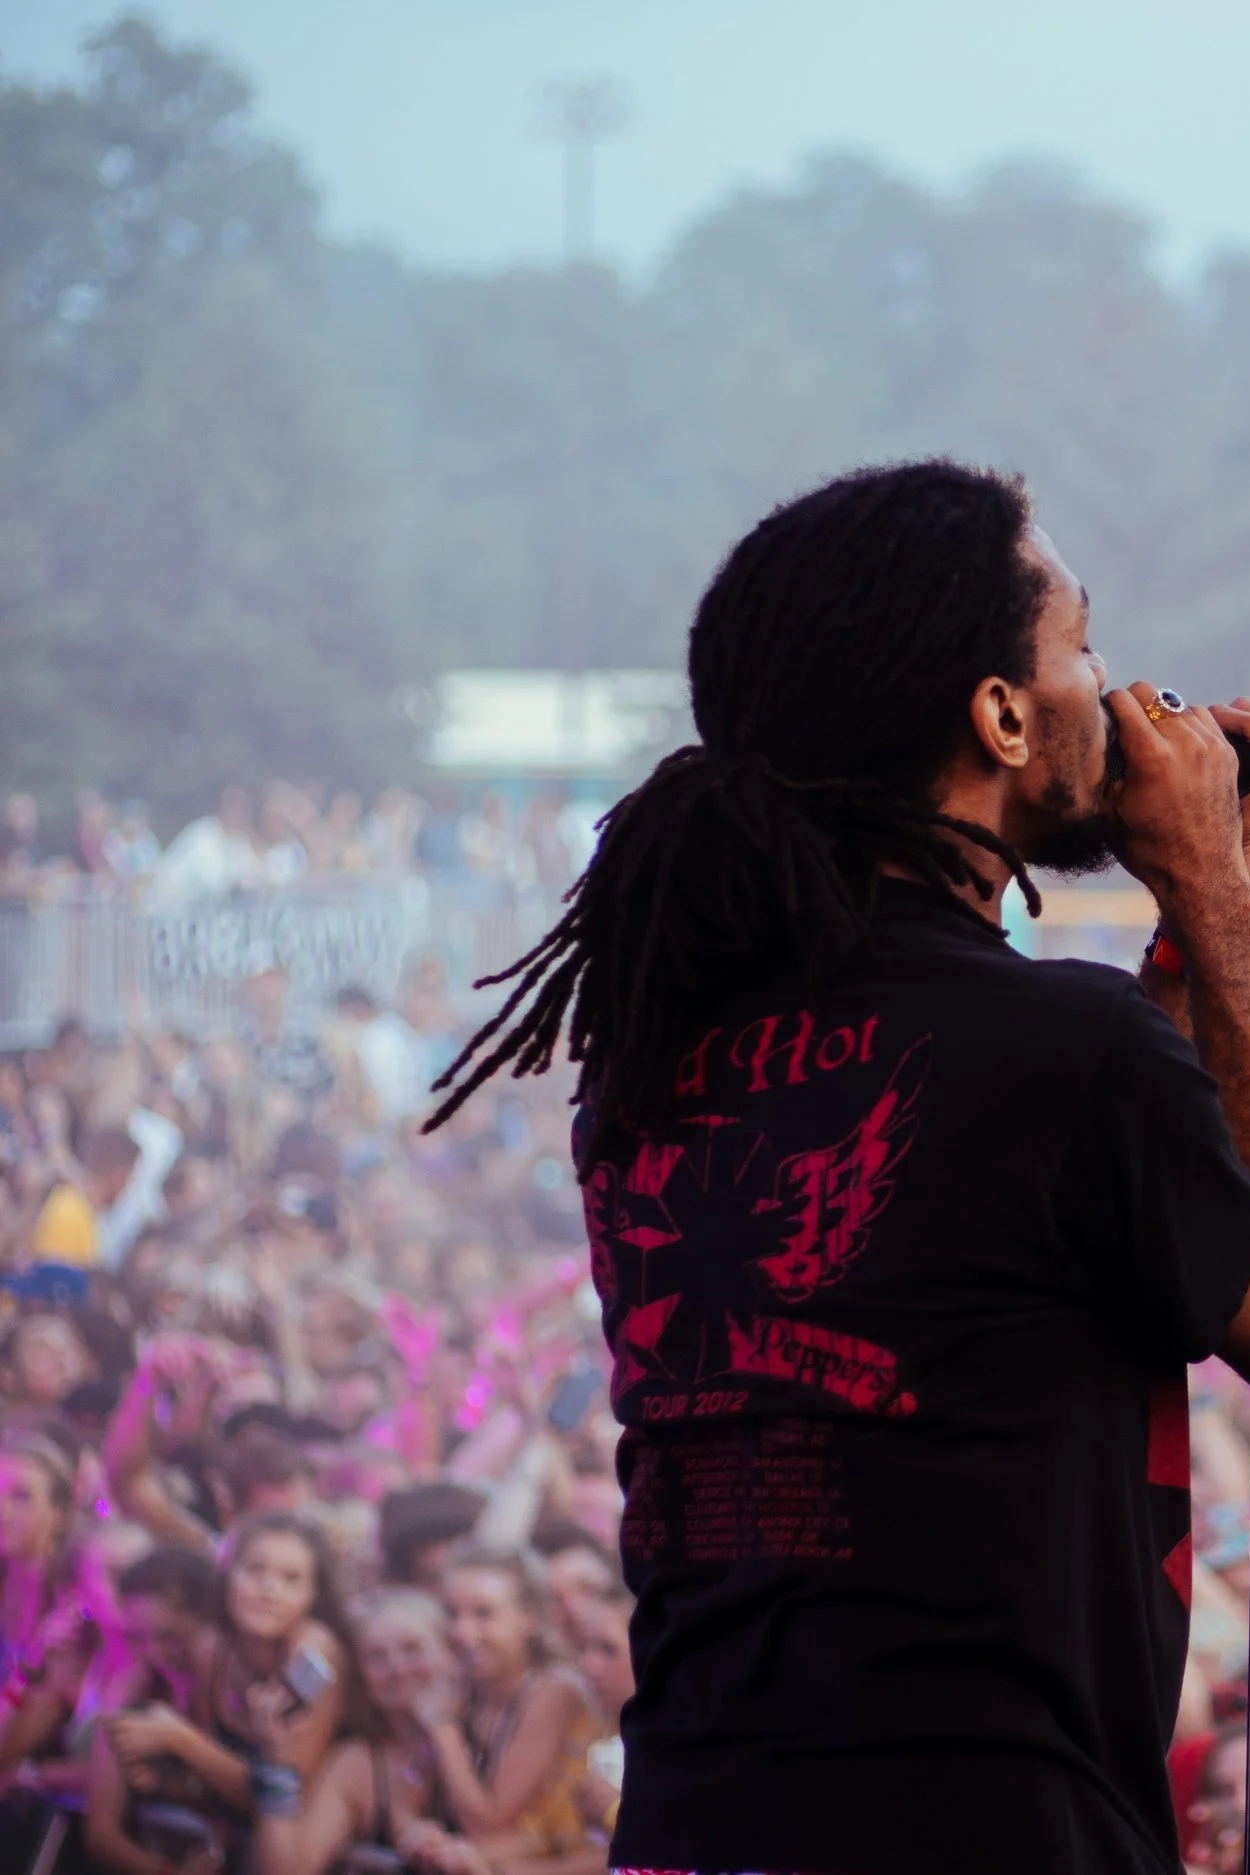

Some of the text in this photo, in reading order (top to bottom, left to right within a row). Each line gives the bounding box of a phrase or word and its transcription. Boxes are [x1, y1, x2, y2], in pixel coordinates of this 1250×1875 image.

[728, 1009, 878, 1093] Hot
[748, 1321, 888, 1393] Peppers
[641, 1391, 748, 1419] TOUR 2012
